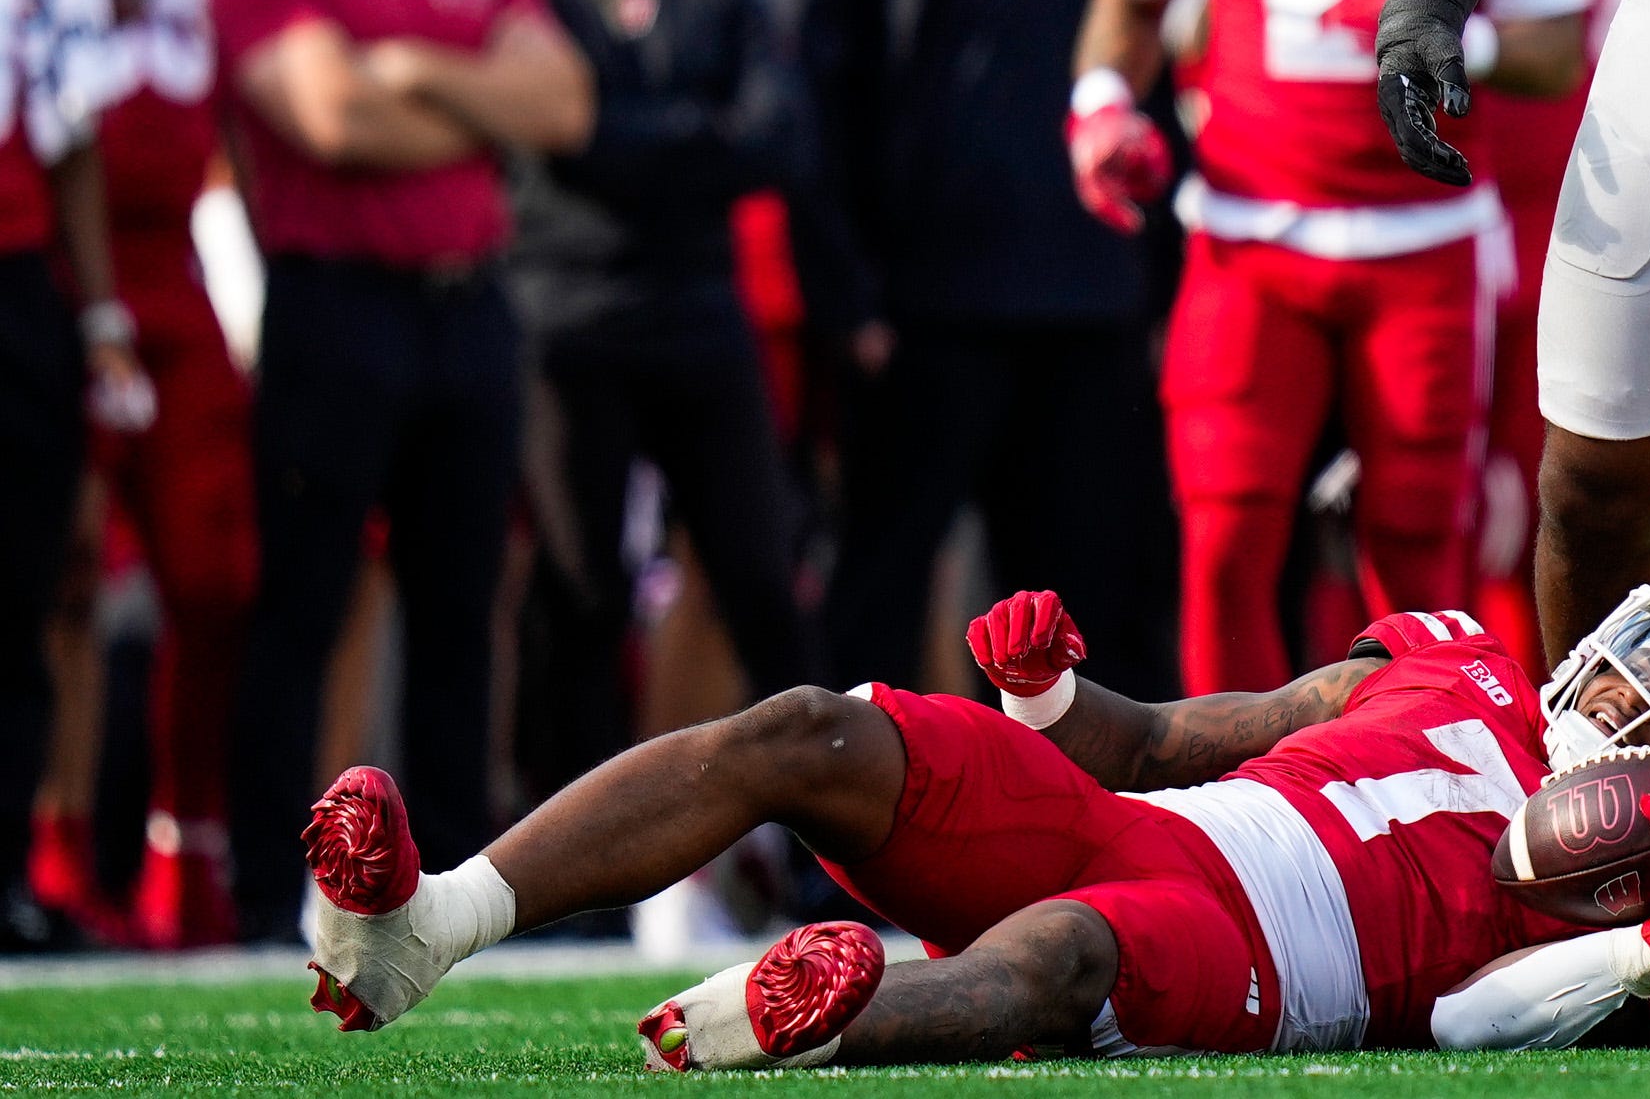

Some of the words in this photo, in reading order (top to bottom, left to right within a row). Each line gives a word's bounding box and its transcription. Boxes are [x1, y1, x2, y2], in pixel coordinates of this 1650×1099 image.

[1319, 719, 1529, 842] 7
[1547, 774, 1636, 854] W
[1594, 870, 1644, 916] W
